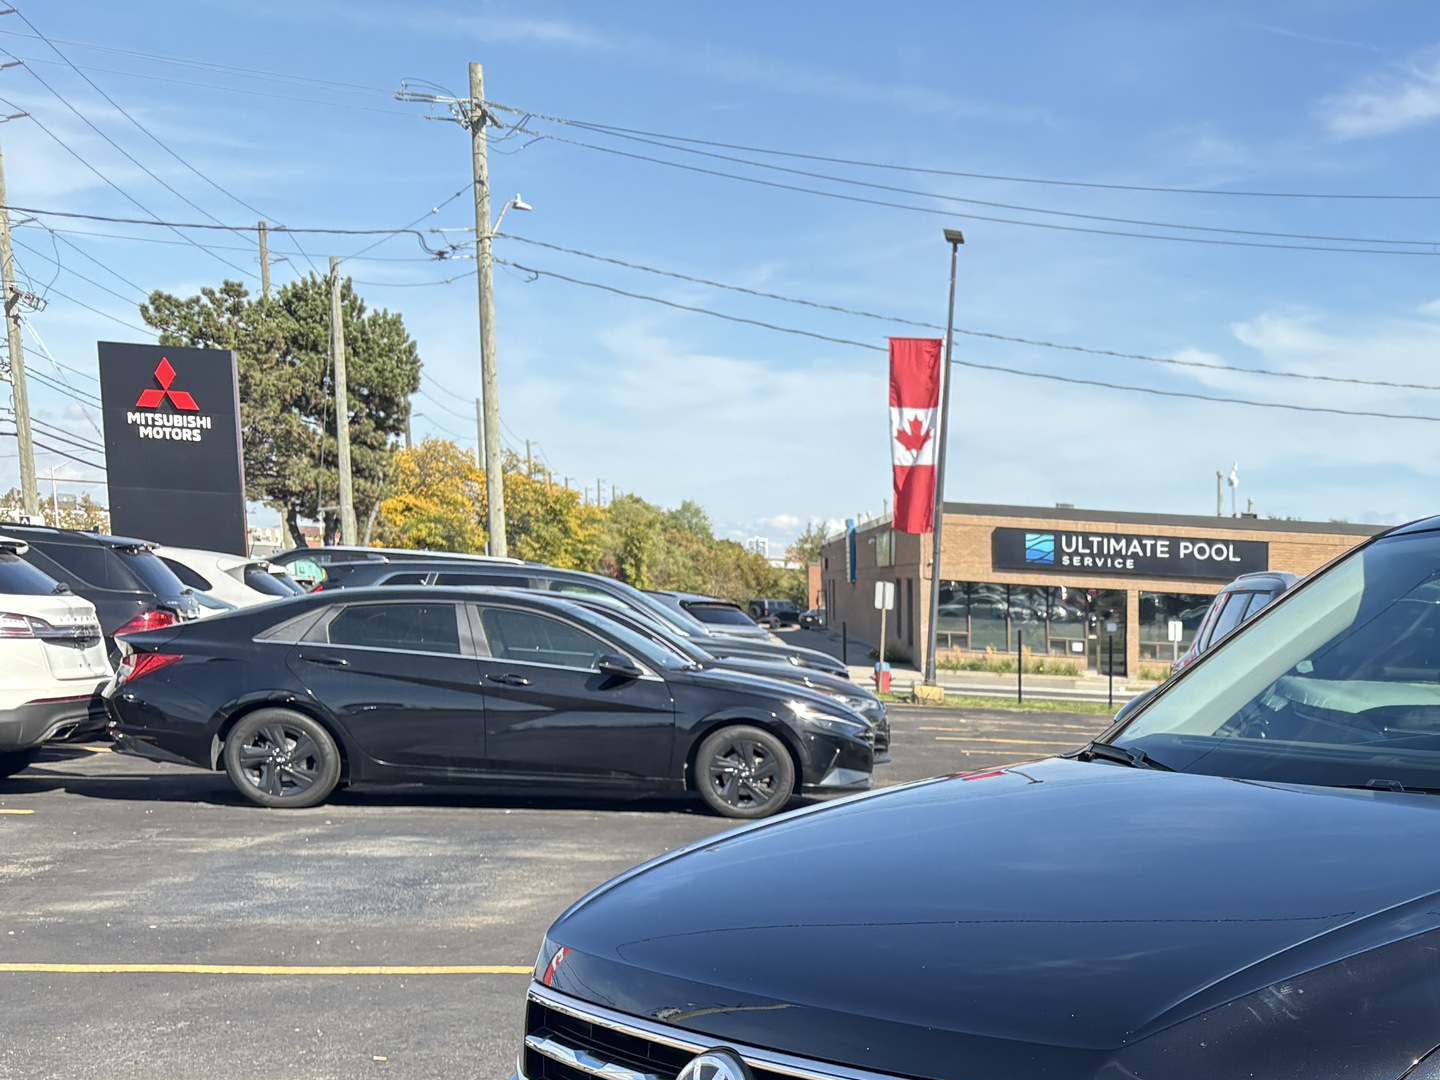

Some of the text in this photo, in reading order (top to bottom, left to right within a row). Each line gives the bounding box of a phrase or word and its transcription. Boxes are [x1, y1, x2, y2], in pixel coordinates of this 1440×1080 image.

[127, 412, 211, 429] MITSUBISHI
[139, 426, 202, 442] MOTORS
[1061, 535, 1242, 563] ULTIMATE POOL
[1062, 555, 1135, 570] SERVICE
